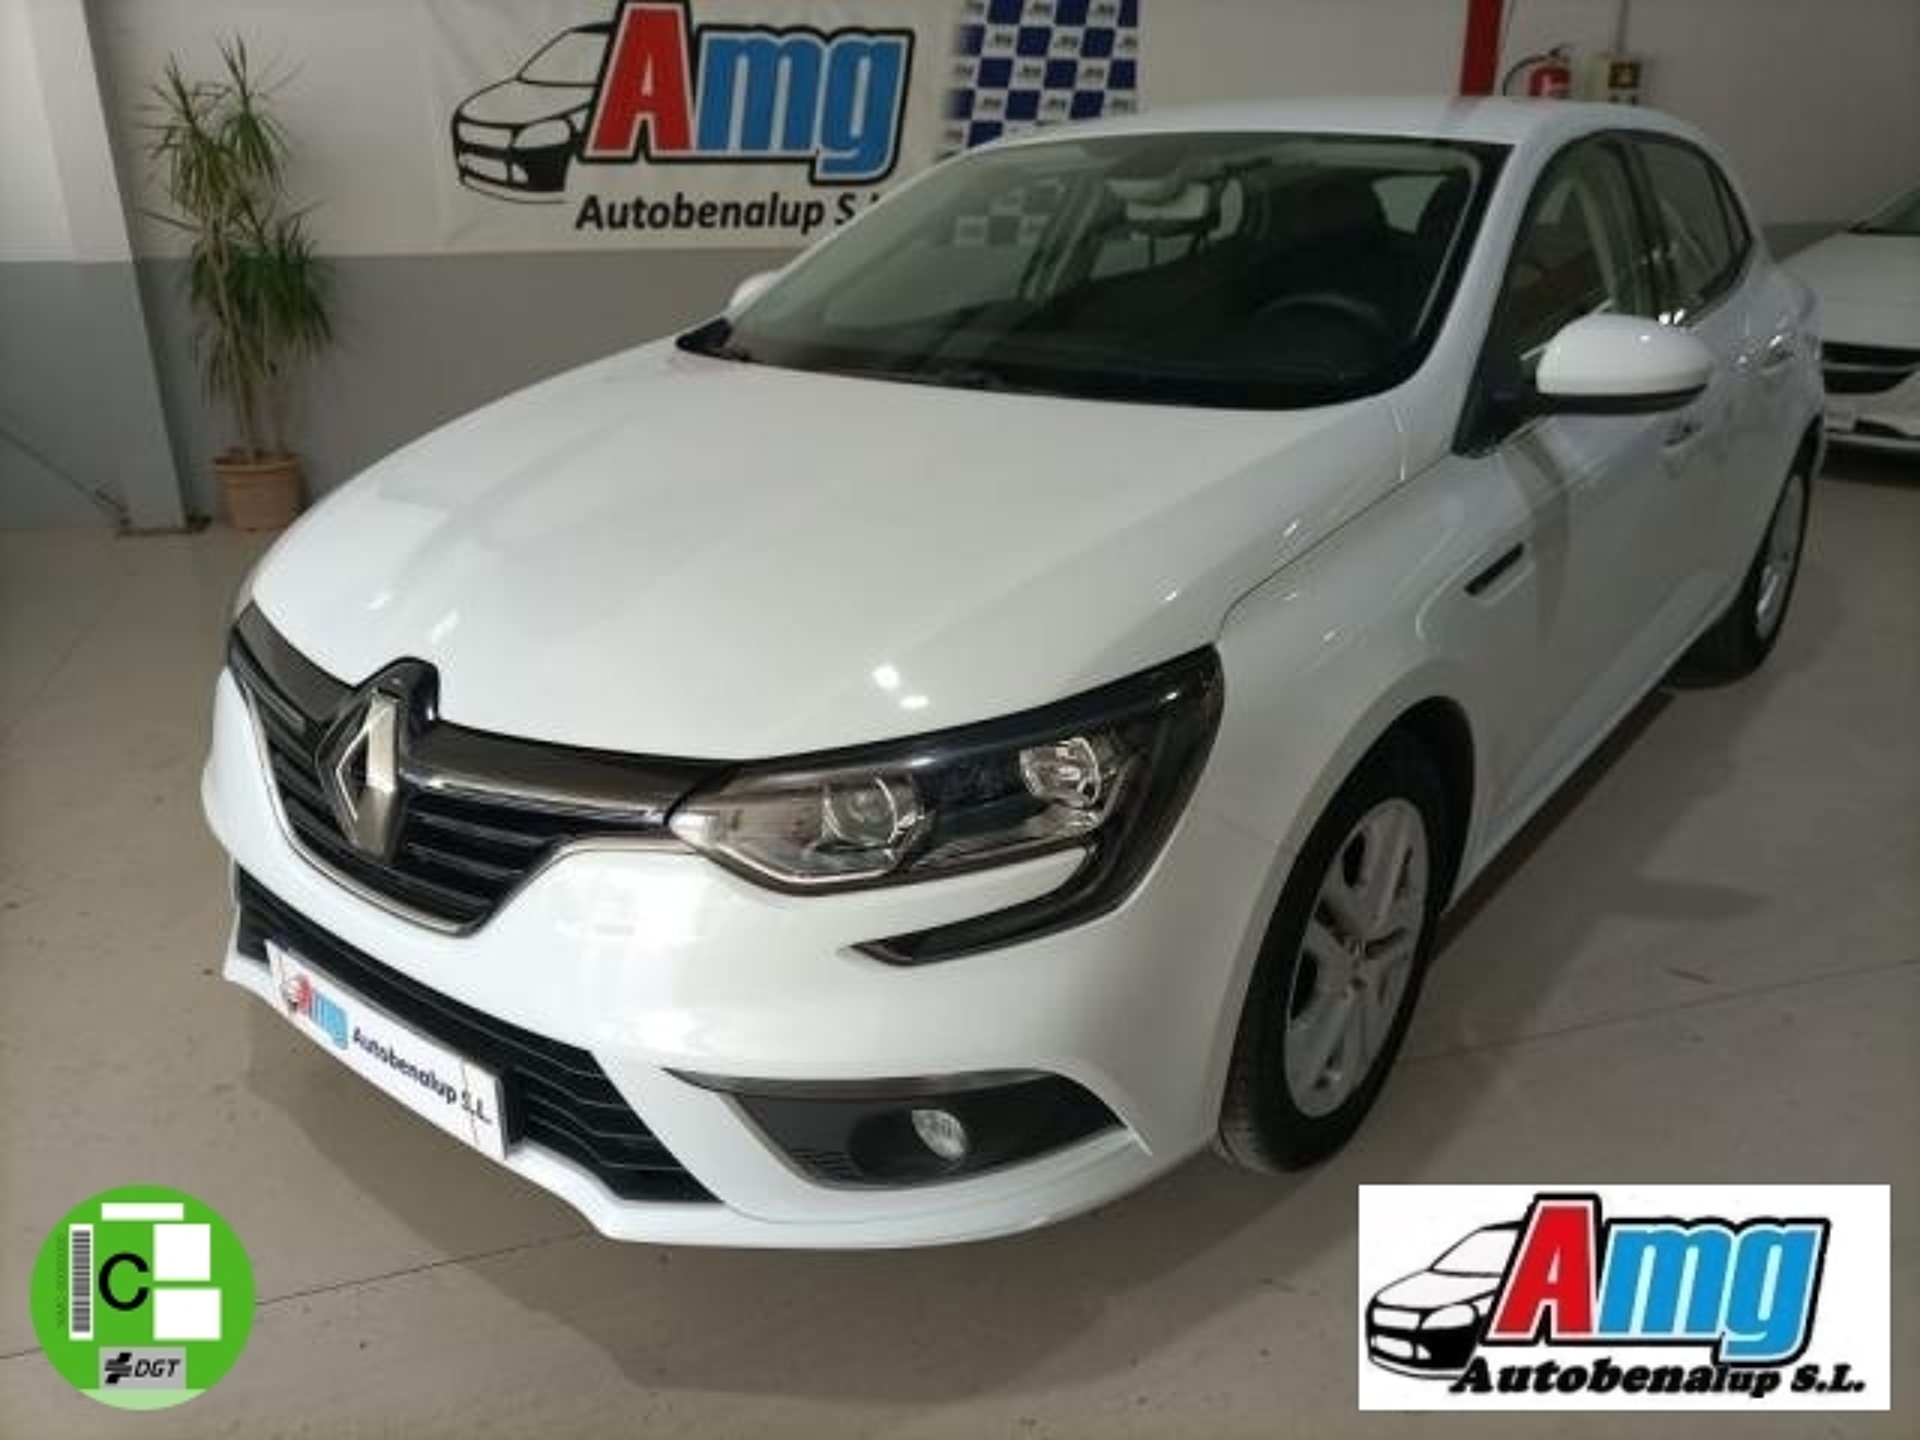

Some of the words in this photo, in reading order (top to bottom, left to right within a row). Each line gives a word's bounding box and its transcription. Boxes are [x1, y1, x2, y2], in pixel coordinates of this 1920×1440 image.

[577, 0, 915, 184] Amg
[575, 193, 825, 234] Autobenalup
[353, 1027, 457, 1105] Autobenalup
